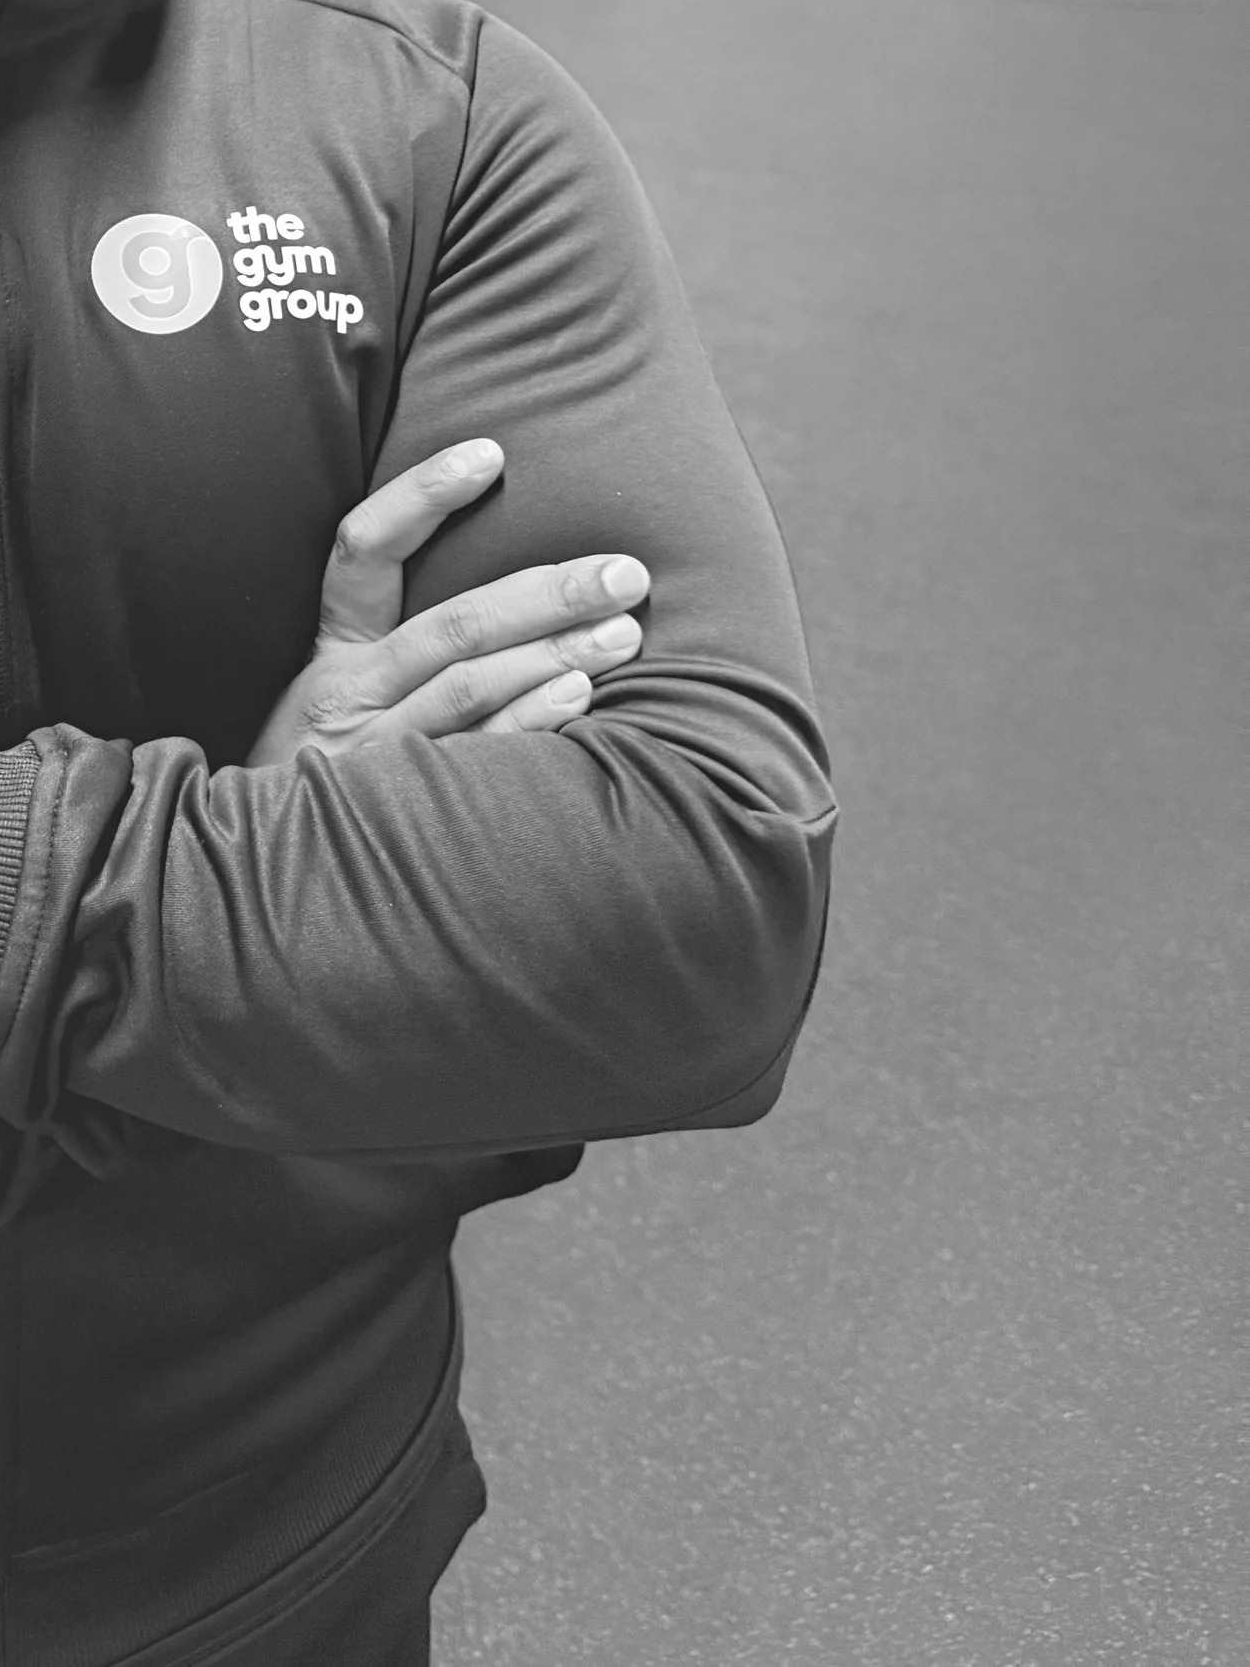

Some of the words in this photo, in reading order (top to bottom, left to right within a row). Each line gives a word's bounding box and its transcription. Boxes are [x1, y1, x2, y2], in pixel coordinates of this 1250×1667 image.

[227, 206, 305, 243] the
[233, 245, 336, 287] gym
[239, 288, 364, 334] group
